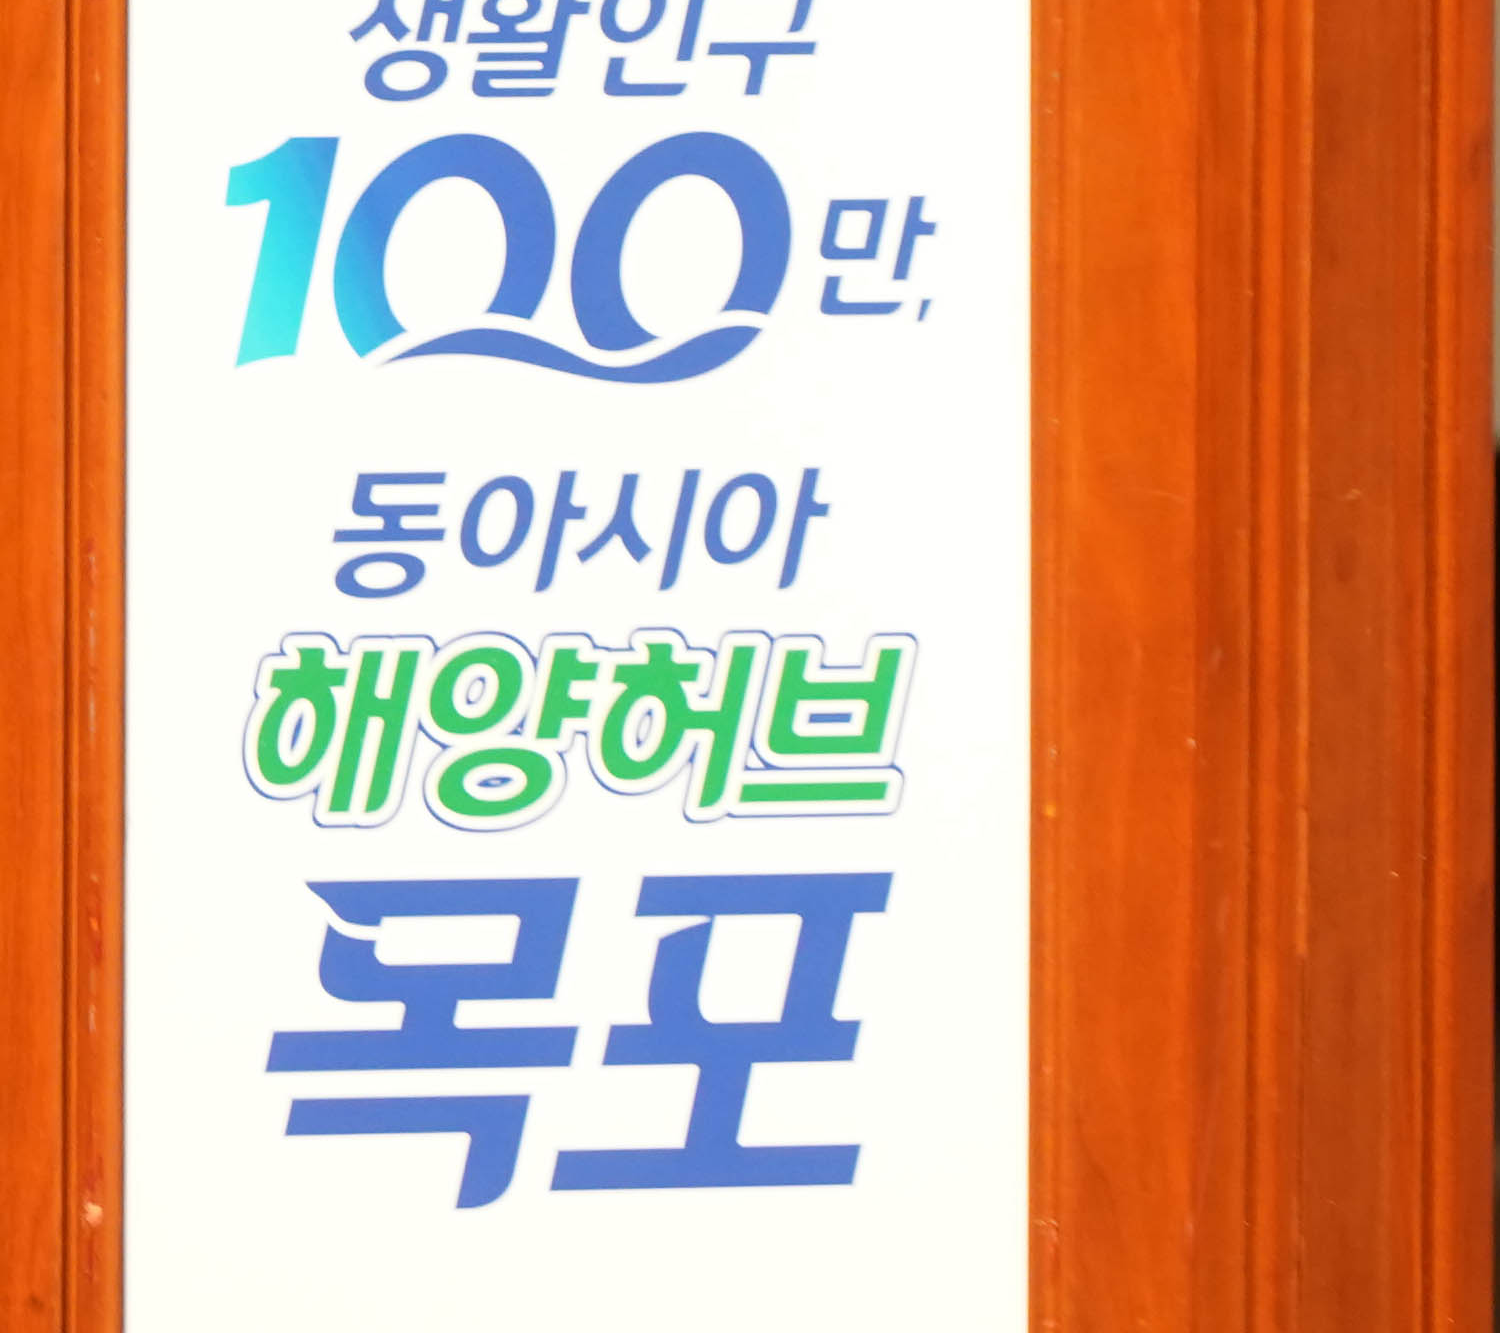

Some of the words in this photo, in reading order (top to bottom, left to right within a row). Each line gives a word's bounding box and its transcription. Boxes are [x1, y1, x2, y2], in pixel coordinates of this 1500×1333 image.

[333, 468, 830, 598] 동아시아
[254, 641, 906, 820] 해양허브
[264, 871, 894, 1209] 목포
